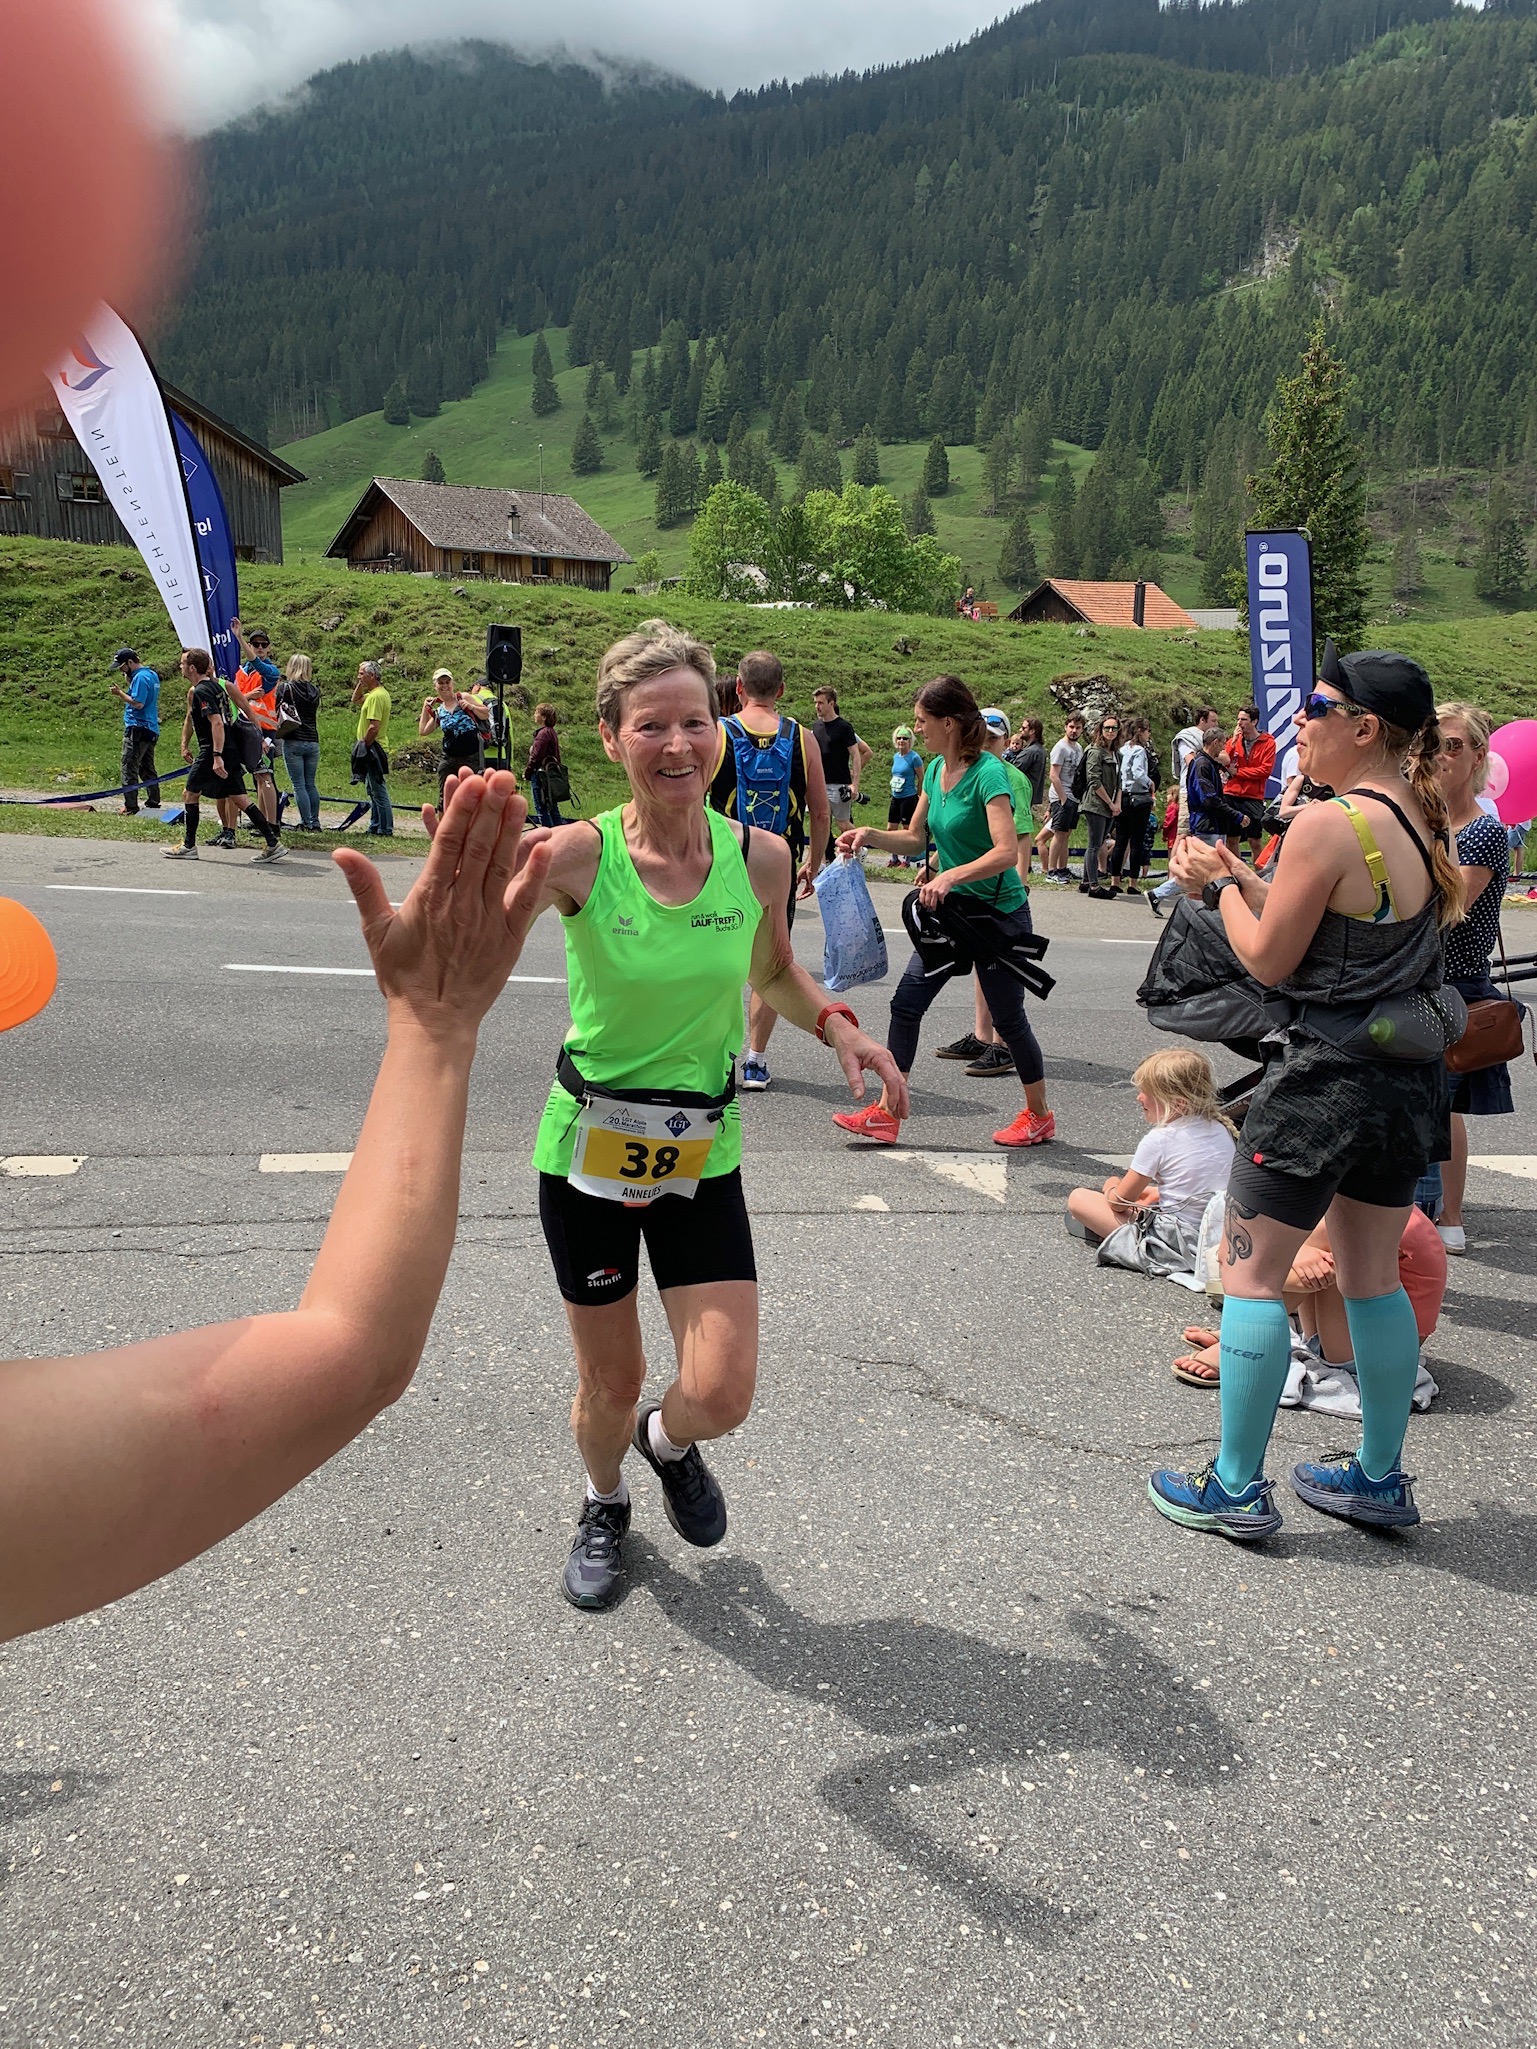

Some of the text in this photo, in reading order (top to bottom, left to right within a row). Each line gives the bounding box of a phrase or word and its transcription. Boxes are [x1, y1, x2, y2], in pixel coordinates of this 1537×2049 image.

[612, 927, 639, 936] erima
[668, 1119, 688, 1129] LGT
[619, 1142, 680, 1179] 38
[587, 1272, 622, 1288] skinfit
[1232, 1348, 1265, 1361] cep
